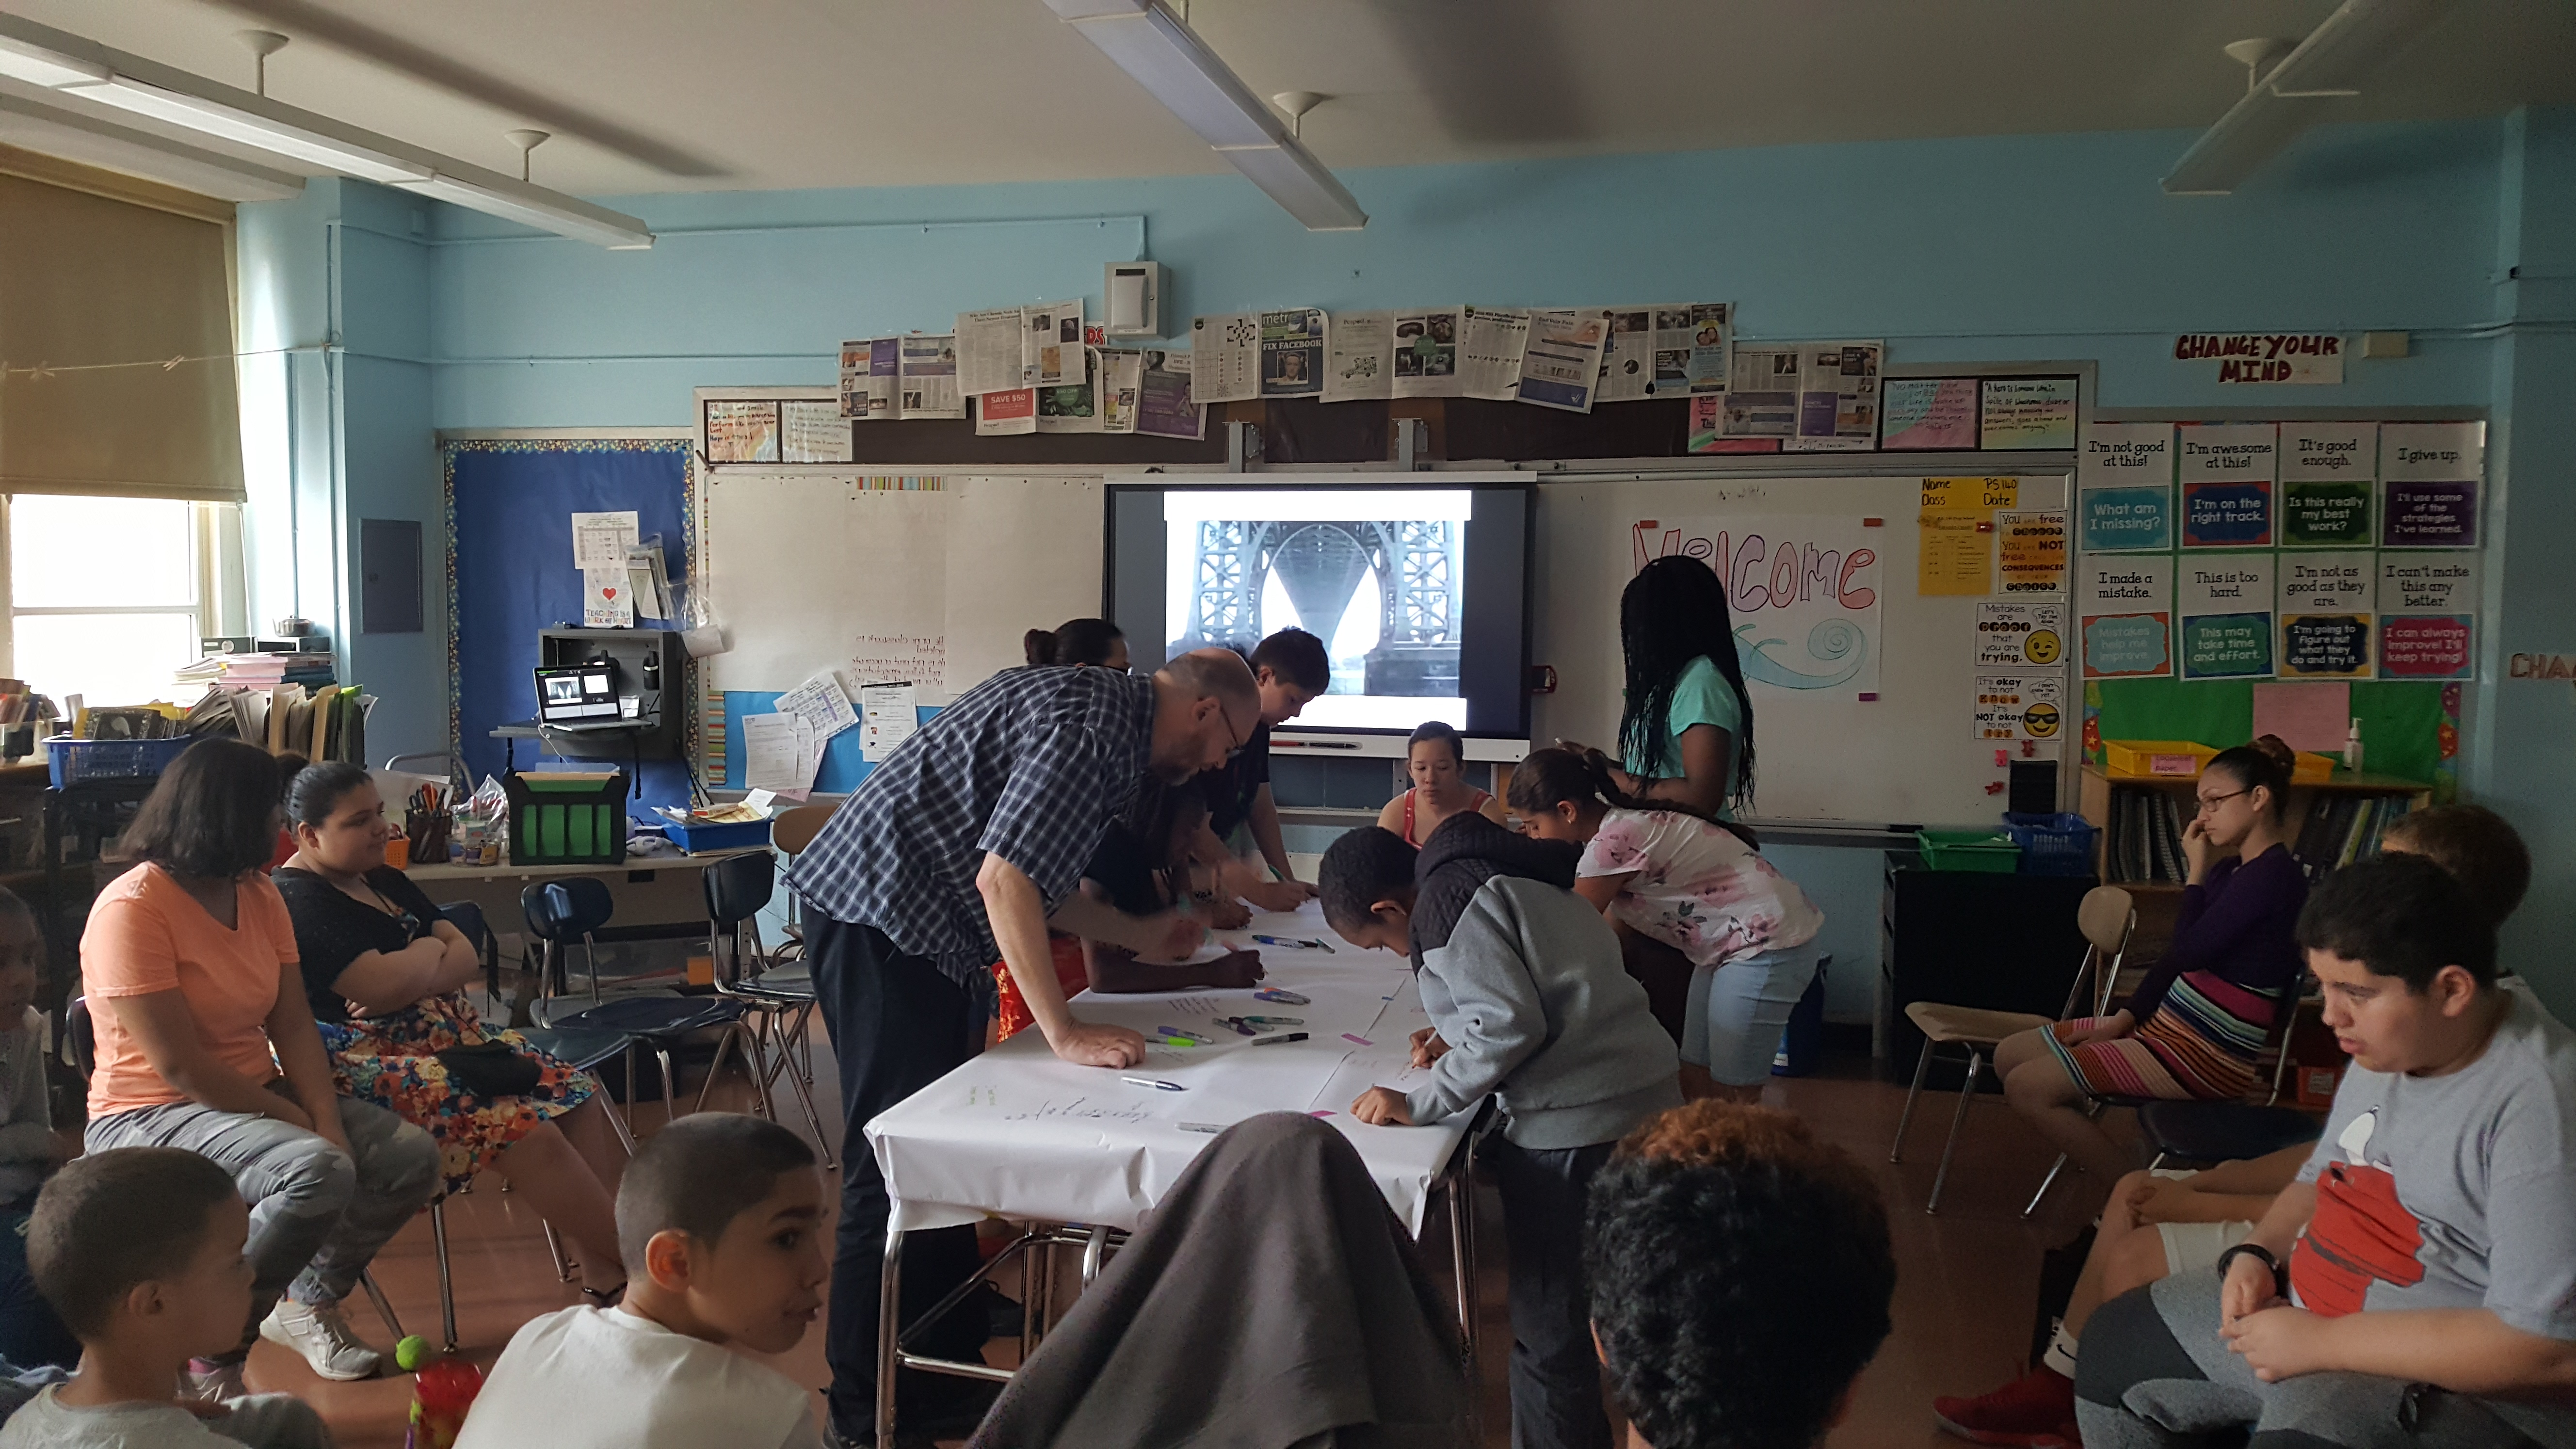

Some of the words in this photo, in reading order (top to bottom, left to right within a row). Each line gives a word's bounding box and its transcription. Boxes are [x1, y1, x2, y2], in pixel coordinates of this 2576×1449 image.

[1262, 313, 1288, 325] metr
[1263, 341, 1277, 351] FIX
[1278, 339, 1322, 349] FACEBOOK
[2175, 335, 2261, 360] CHANGE
[2263, 335, 2340, 359] YOUR
[2218, 360, 2292, 383] MIND
[1012, 394, 1026, 402] $50
[2089, 441, 2110, 453] I'm
[2114, 442, 2132, 452] not
[2135, 440, 2165, 455] good
[2186, 443, 2209, 454] I'm
[2211, 444, 2272, 454] awesome
[2299, 439, 2324, 451] It's
[2326, 438, 2357, 454] good
[2104, 456, 2117, 467] at
[2120, 455, 2148, 467] this!
[2206, 457, 2218, 468] at
[2223, 456, 2252, 468] this!
[2302, 454, 2351, 469] enough.
[2398, 448, 2408, 460] I
[2410, 449, 2438, 463] give
[2440, 451, 2462, 464] up.
[1922, 478, 1951, 491] Name
[1983, 478, 2000, 490] PS
[2002, 480, 2017, 490] 140
[1983, 493, 2011, 506] Date
[2194, 499, 2217, 510] I'm
[2220, 500, 2236, 509] on
[2240, 498, 2262, 509] the
[2288, 497, 2301, 507] Is
[2304, 496, 2326, 507] this
[2328, 497, 2365, 508] really
[2094, 503, 2130, 515] What
[2134, 505, 2157, 514] am
[2413, 504, 2426, 512] of
[2430, 504, 2447, 512] the
[2002, 515, 2020, 524] You
[2039, 515, 2064, 524] free
[2191, 512, 2221, 524] right
[2225, 511, 2265, 522] track.
[2301, 511, 2320, 521] my
[2322, 509, 2351, 518] best
[2090, 518, 2097, 530] I
[2102, 516, 2160, 531] missing?
[2308, 521, 2348, 531] work?
[2395, 525, 2415, 533] I've
[2002, 541, 2020, 550] You
[2039, 541, 2064, 550] NOT
[2000, 552, 2026, 562] free
[2195, 572, 2222, 583] This
[2225, 573, 2236, 582] is
[2240, 571, 2258, 582] too
[2295, 565, 2318, 577] I'm
[2321, 565, 2341, 577] not
[2344, 568, 2359, 576] as
[2386, 565, 2395, 577] I
[2398, 565, 2430, 577] can't
[2433, 565, 2470, 577] make
[2098, 572, 2107, 583] I
[2110, 572, 2141, 583] made
[2145, 575, 2153, 583] a
[2098, 586, 2152, 598] mistake.
[2210, 585, 2242, 597] hard.
[2287, 580, 2318, 596] good
[2320, 583, 2334, 592] as
[2337, 580, 2366, 595] they
[2401, 580, 2426, 592] this
[2429, 583, 2453, 595] any
[2200, 628, 2222, 637] This
[2225, 628, 2252, 638] may
[2293, 625, 2312, 634] I'm
[2314, 627, 2342, 635] going
[2345, 625, 2356, 633] to
[2386, 628, 2393, 638] I
[2421, 628, 2465, 639] always
[2198, 640, 2224, 650] take
[2228, 639, 2256, 648] time
[2327, 646, 2351, 655] they
[1981, 652, 2023, 663] trying.
[2193, 651, 2214, 662] and
[2219, 650, 2260, 660] effort.
[2290, 656, 2304, 664] do
[2306, 656, 2326, 664] and
[2328, 656, 2346, 665] try
[2387, 653, 2418, 663] keep
[2510, 653, 2576, 678] CHA
[1996, 678, 2021, 687] okay
[1998, 713, 2023, 723] okay
